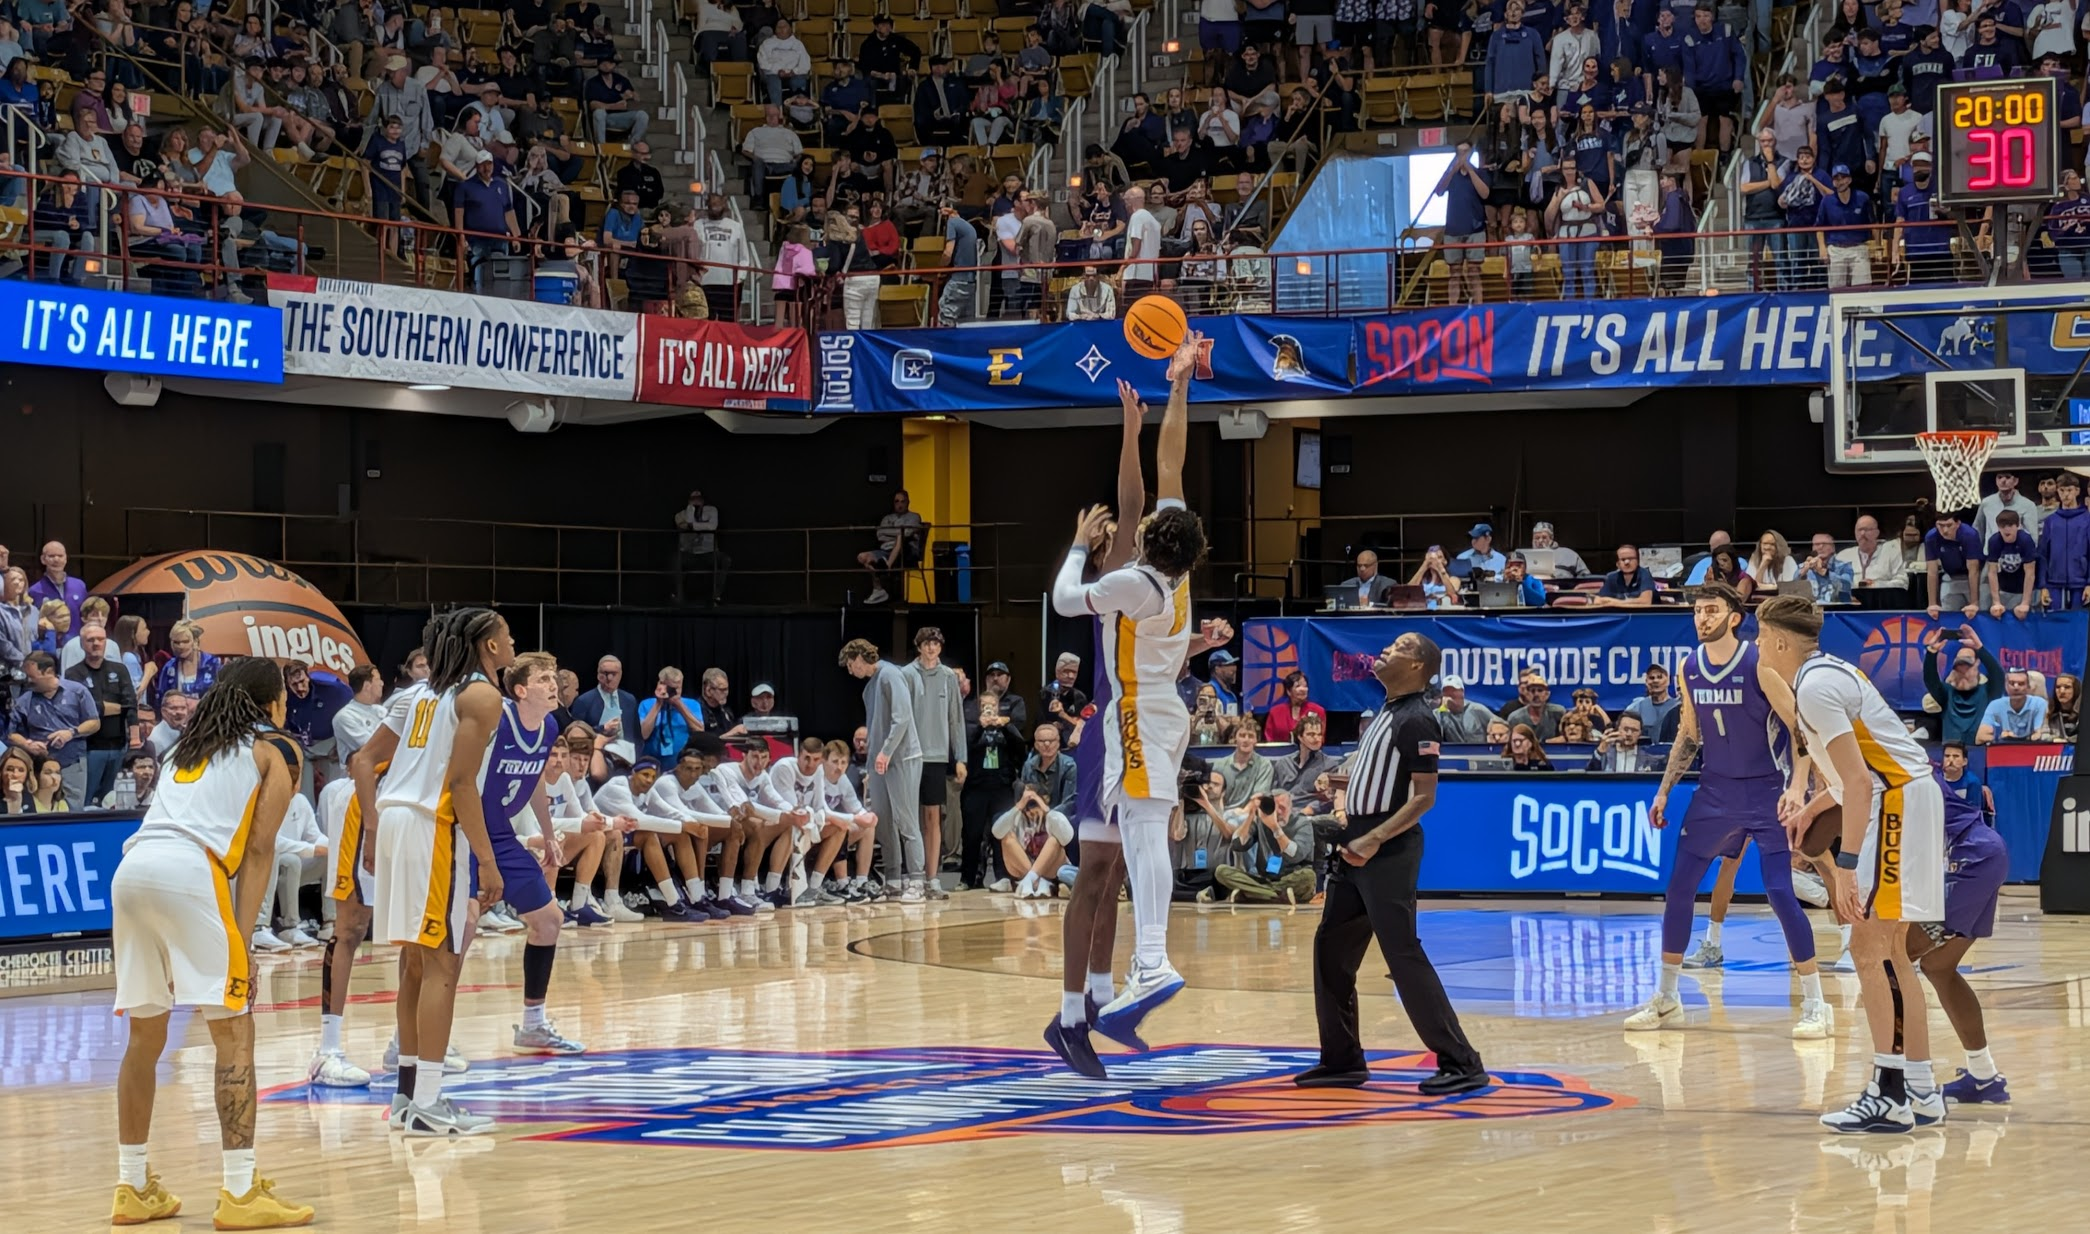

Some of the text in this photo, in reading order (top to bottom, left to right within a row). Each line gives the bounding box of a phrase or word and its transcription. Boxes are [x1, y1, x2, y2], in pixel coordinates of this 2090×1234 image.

[1954, 93, 2044, 128] 20:00
[1968, 127, 2035, 191] 30
[22, 299, 259, 369] IT'S ALL HERE.
[284, 300, 625, 380] THE SOUTHERN CONFERENCE
[1526, 312, 1627, 377] IT'S
[1632, 309, 1724, 374] ALL
[658, 338, 796, 393] IT'S ALL HERE.
[242, 616, 356, 675] ingles
[1429, 646, 1600, 686] OURTSIDE
[408, 698, 440, 748] 11
[1712, 708, 1726, 737] 1
[501, 779, 523, 807] 3
[1883, 813, 1902, 884] BUCS
[0, 841, 106, 917] ERE
